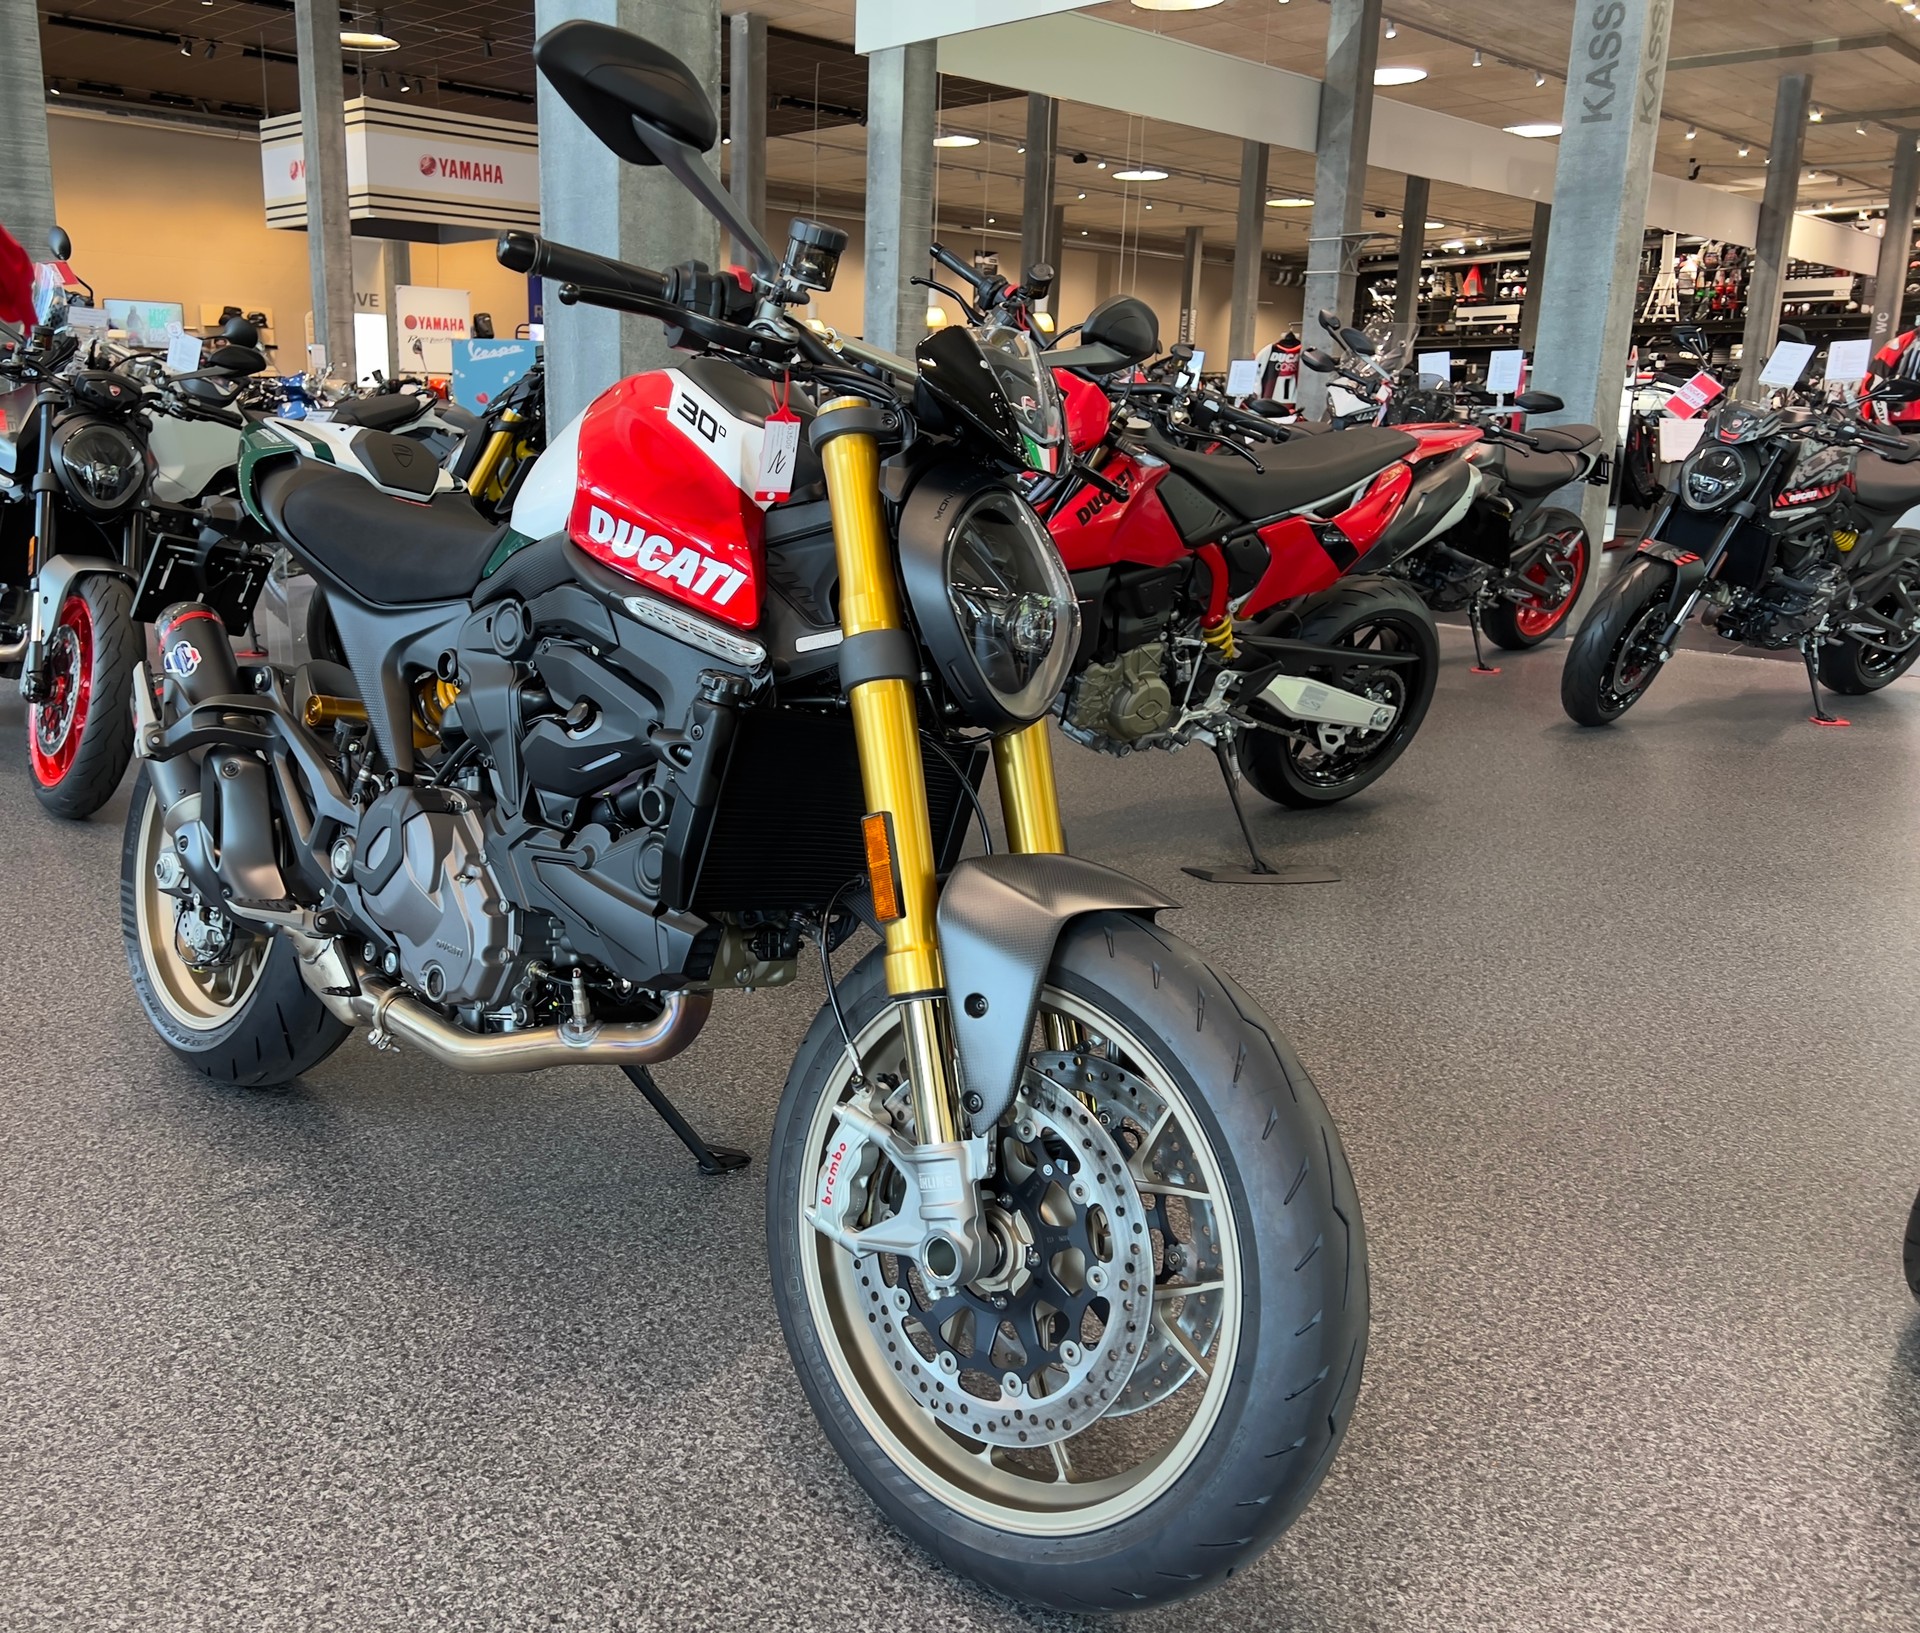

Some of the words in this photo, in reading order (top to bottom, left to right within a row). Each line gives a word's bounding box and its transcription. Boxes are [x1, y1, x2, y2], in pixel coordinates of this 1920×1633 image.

[438, 157, 504, 185] YAMAHA
[418, 316, 465, 332] YAMAHA
[1875, 312, 1889, 334] WC
[467, 340, 526, 362] Vespa
[1075, 466, 1136, 527] DUCTI
[587, 504, 749, 606] DUCATI
[821, 1142, 848, 1206] brembo
